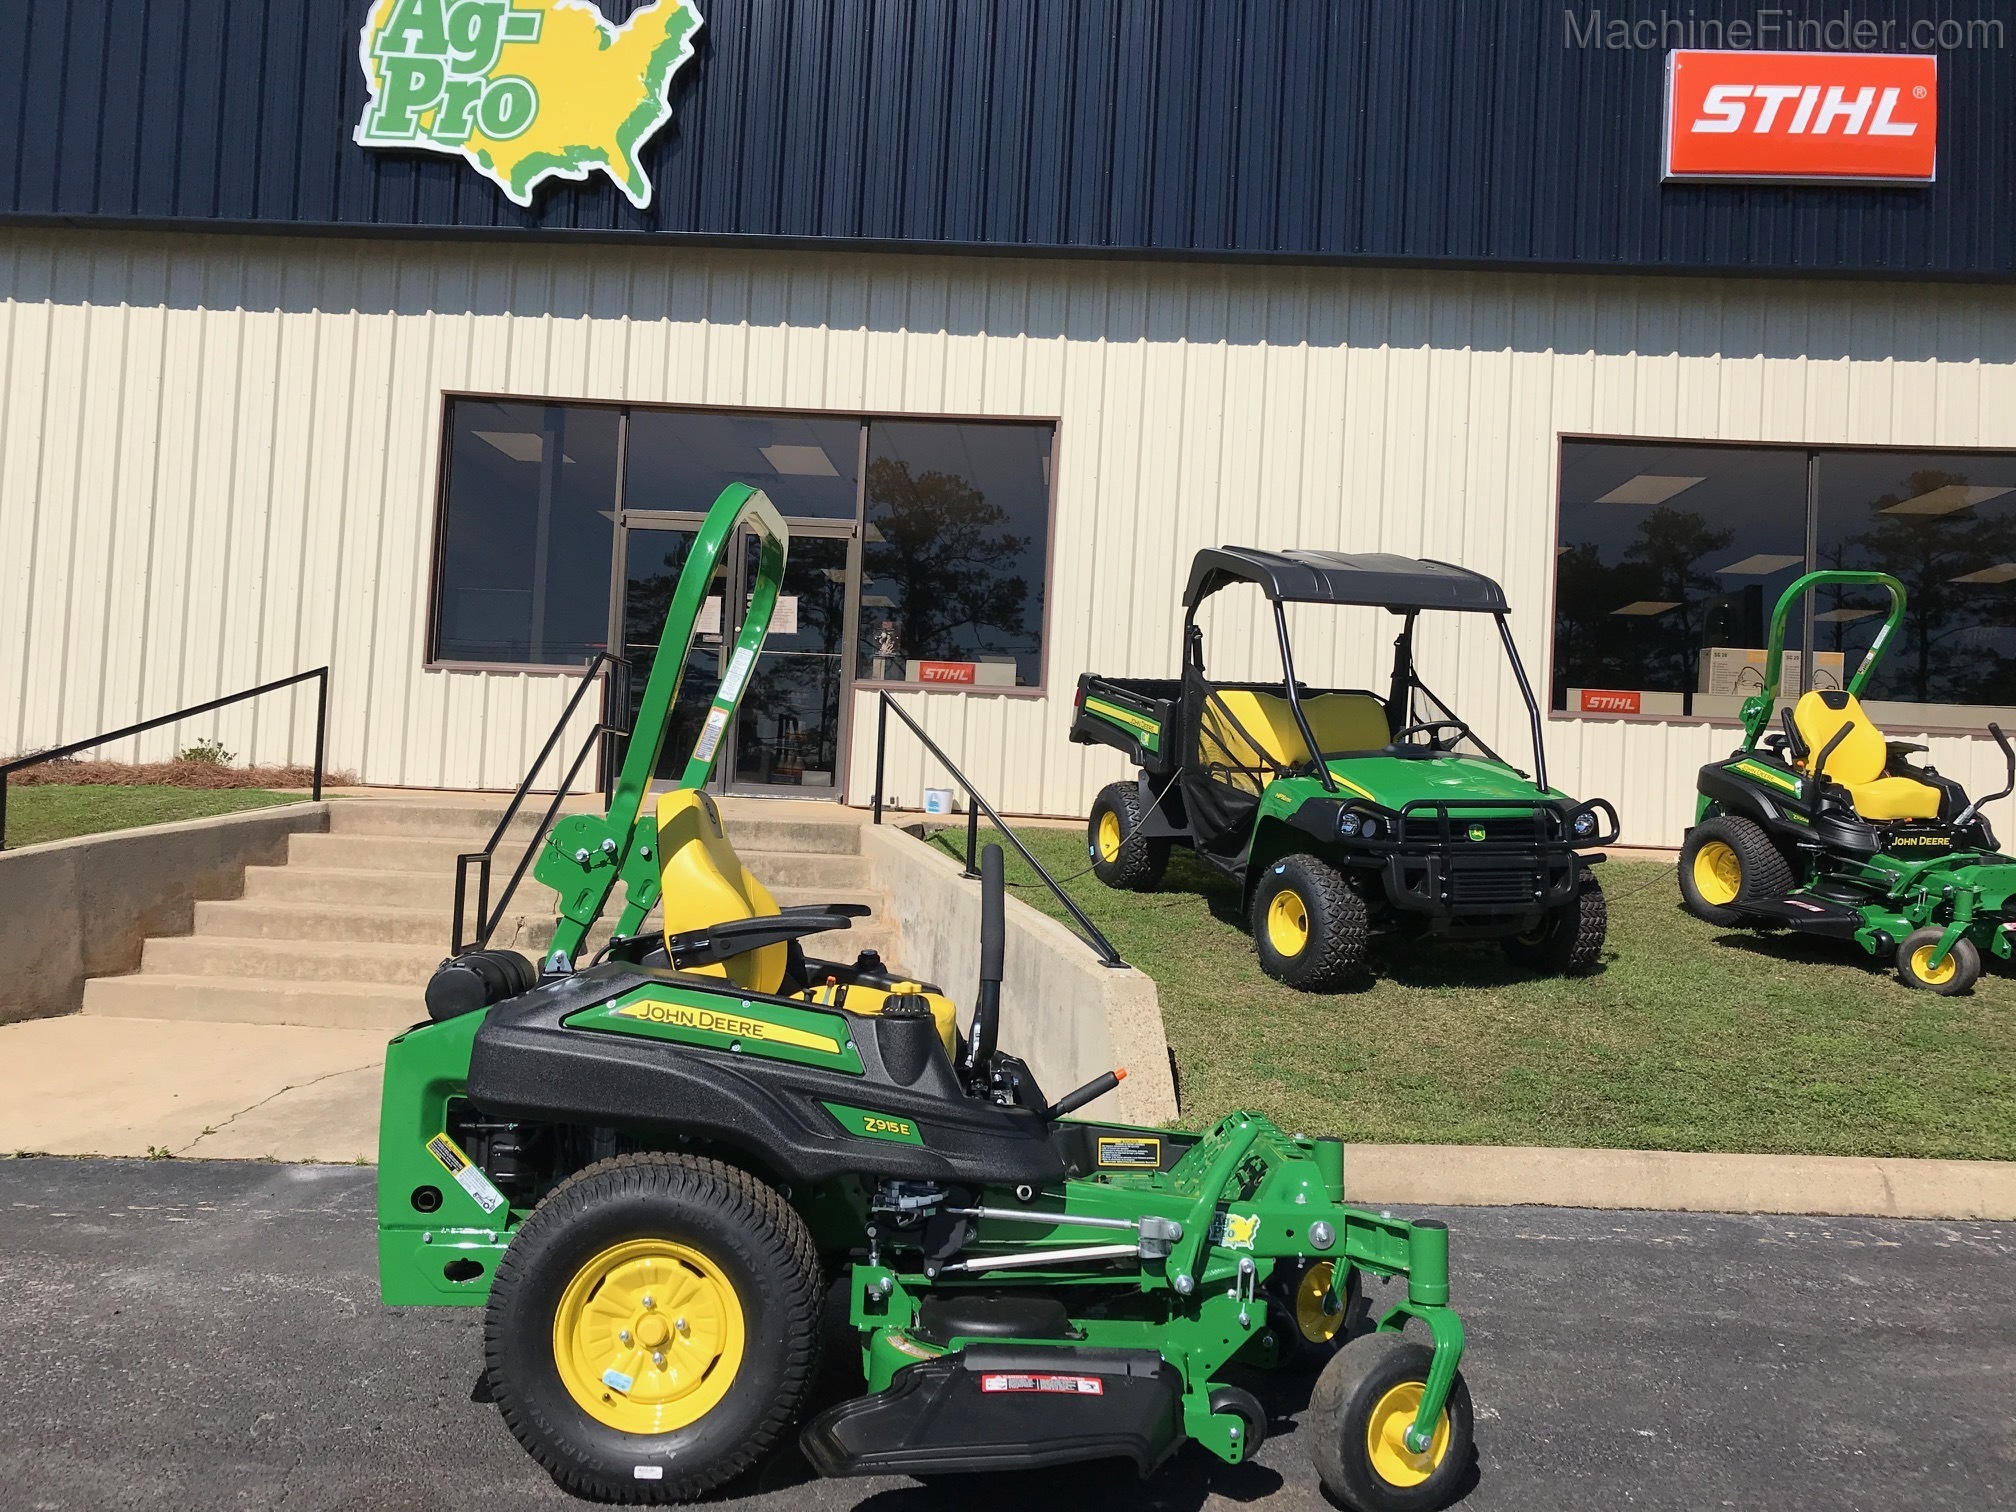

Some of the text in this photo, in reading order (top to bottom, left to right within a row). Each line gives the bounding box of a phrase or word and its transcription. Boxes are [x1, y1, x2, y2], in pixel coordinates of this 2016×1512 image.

[374, 0, 541, 76] Ag-
[369, 54, 538, 139] Pro
[1690, 84, 1919, 137] STIHL
[923, 668, 969, 681] STIHL
[1586, 697, 1636, 710] STIHL
[1742, 765, 1775, 782] JOHN DEERE
[1891, 836, 1951, 846] JOHN DEERE
[638, 1003, 765, 1038] JOHN DEERE
